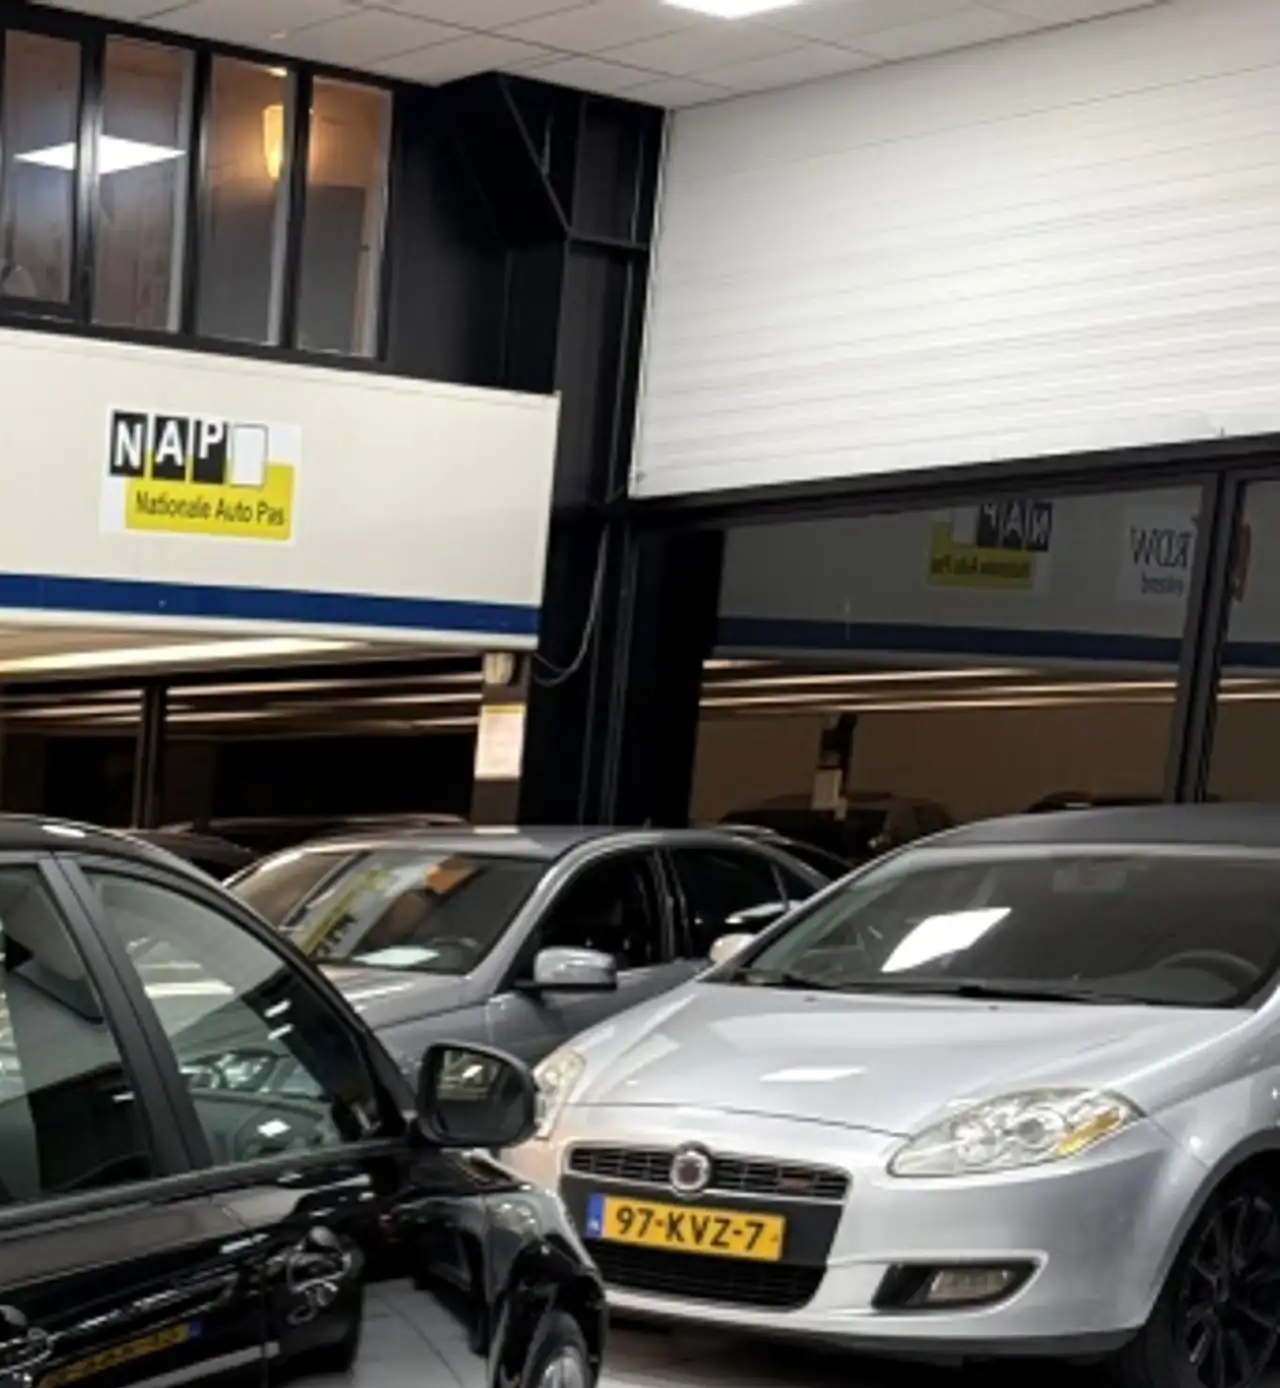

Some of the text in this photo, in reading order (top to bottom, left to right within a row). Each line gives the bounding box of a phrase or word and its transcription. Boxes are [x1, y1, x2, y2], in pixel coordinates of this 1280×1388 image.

[112, 418, 225, 469] NAP
[135, 491, 286, 526] Nationale Auto Pas
[615, 1205, 765, 1252] 97-KVZ-7
